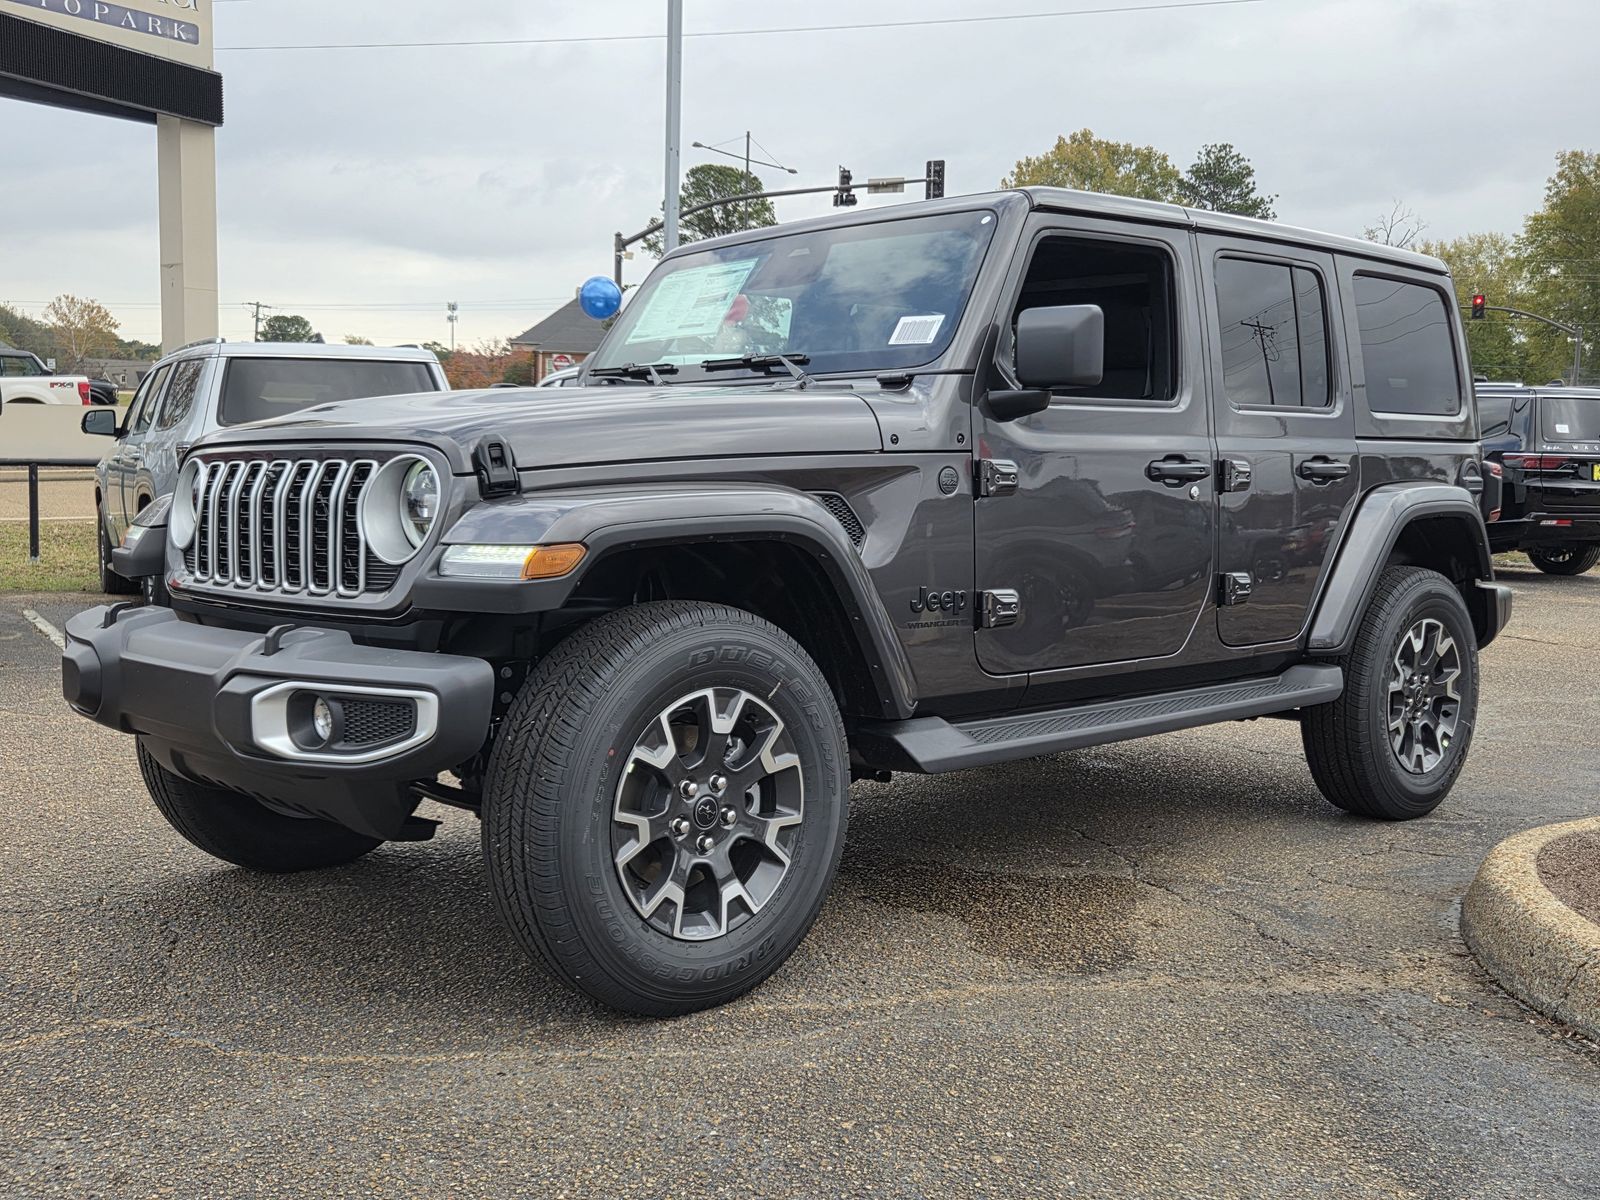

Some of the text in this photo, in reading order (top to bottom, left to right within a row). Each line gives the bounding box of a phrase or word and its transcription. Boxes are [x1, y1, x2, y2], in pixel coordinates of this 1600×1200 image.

[905, 619, 960, 629] WRANGLER
[910, 585, 967, 616] Jeep
[687, 644, 826, 732] DUELER
[583, 872, 777, 983] BRIDGESTONE
